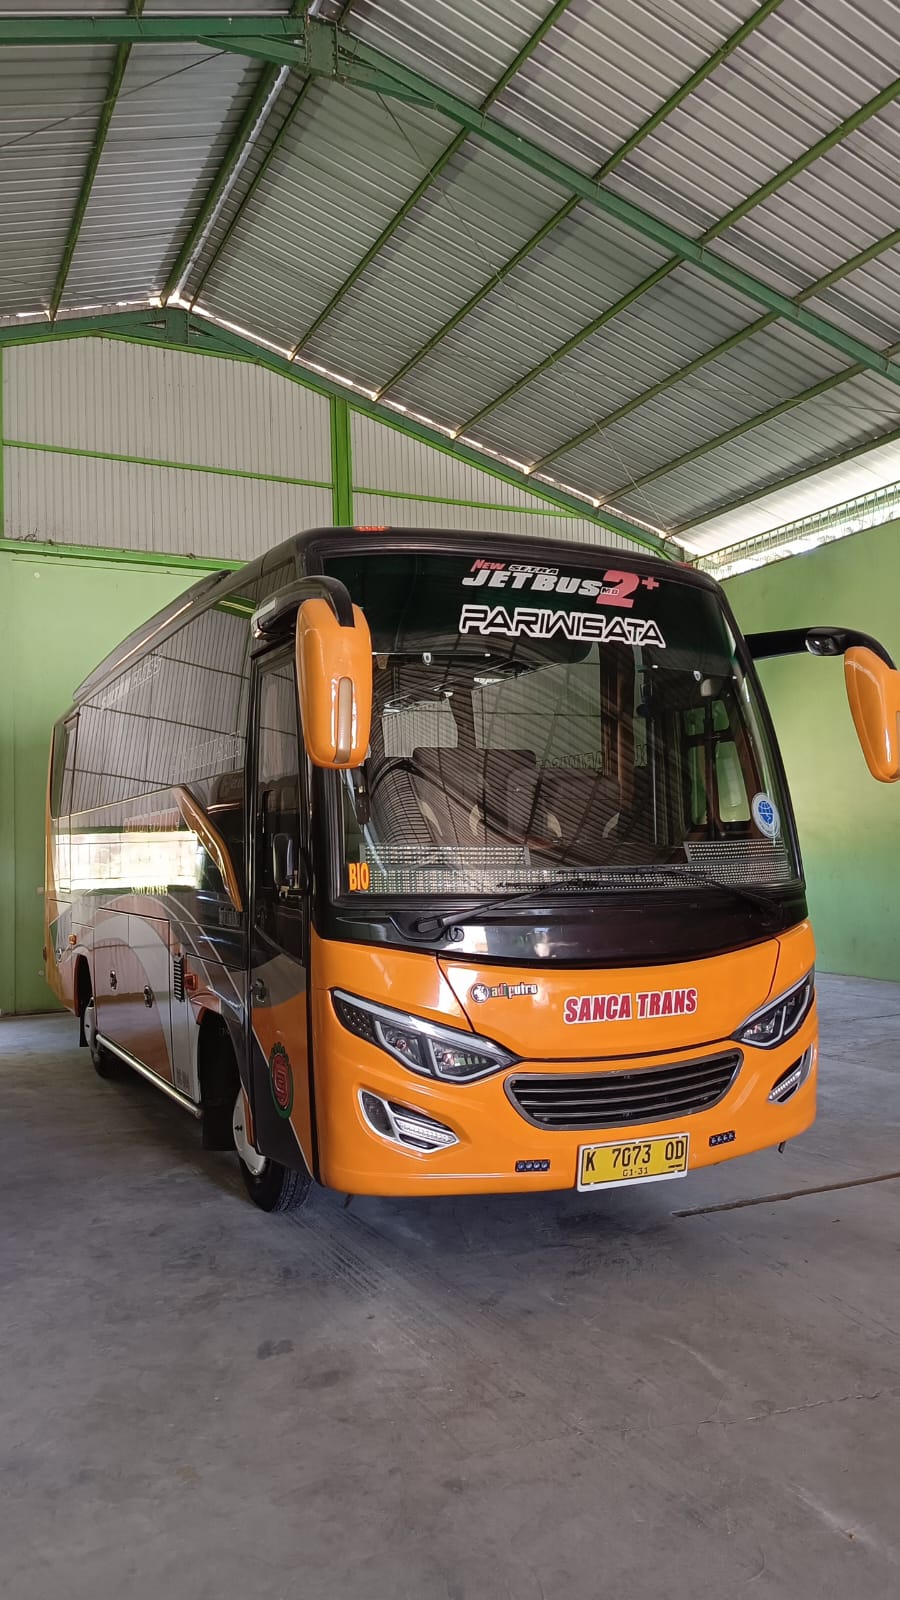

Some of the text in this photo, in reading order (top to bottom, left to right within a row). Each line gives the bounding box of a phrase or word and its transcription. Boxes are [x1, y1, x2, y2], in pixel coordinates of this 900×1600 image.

[459, 604, 666, 648] PARIWISATA
[564, 989, 697, 1024] SANCA TRANS
[585, 1151, 596, 1172] K
[612, 1144, 651, 1168] 7073
